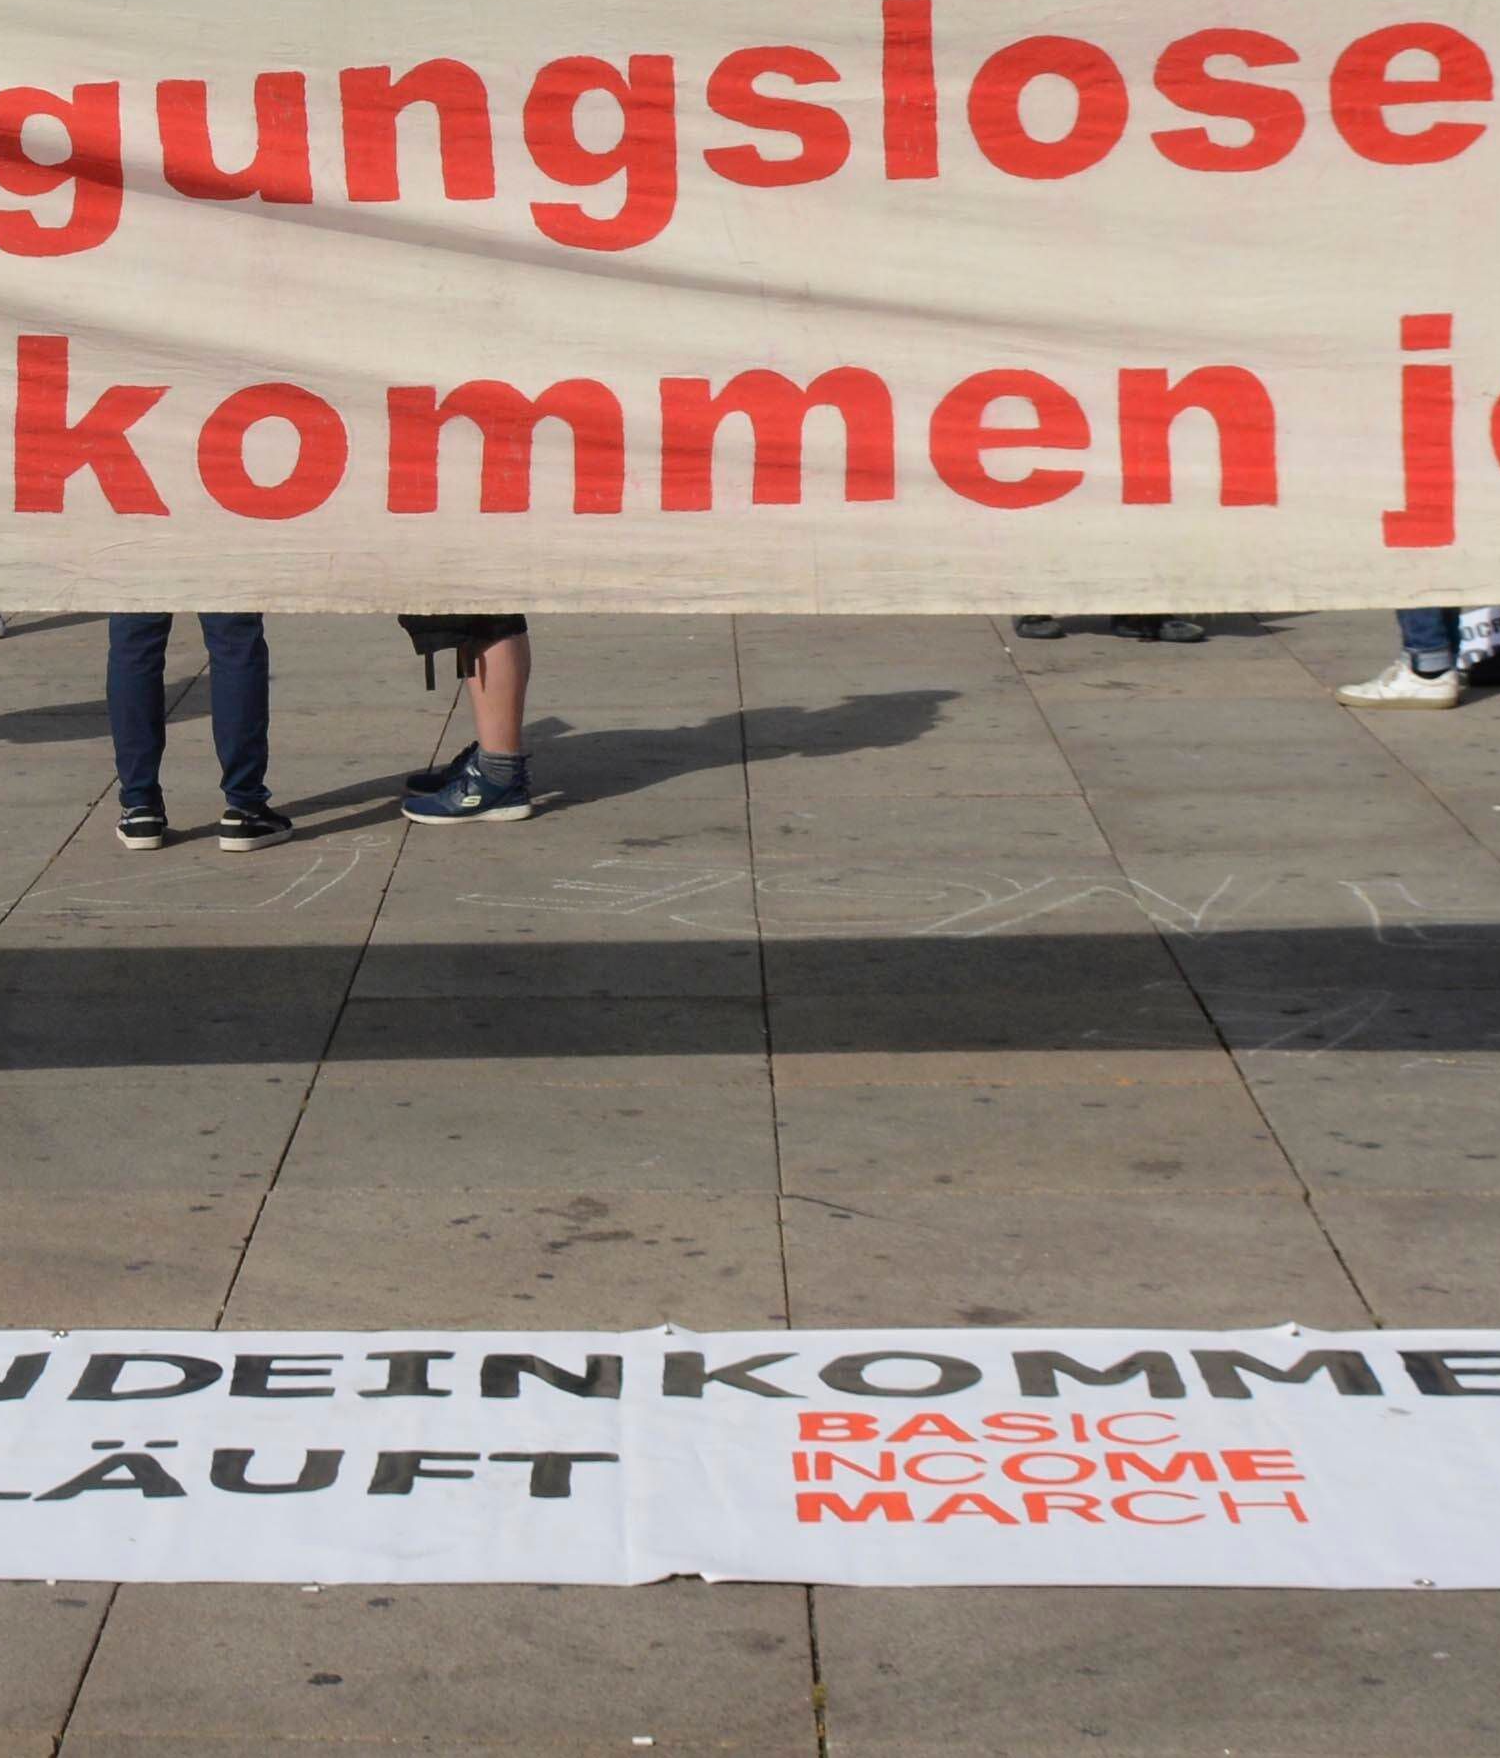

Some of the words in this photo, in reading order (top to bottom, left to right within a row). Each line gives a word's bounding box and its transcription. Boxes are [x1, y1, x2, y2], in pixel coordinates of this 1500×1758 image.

[795, 1412, 1182, 1444] BASIC
[791, 1450, 1308, 1484] INCOME
[795, 1492, 1309, 1525] MARCH
